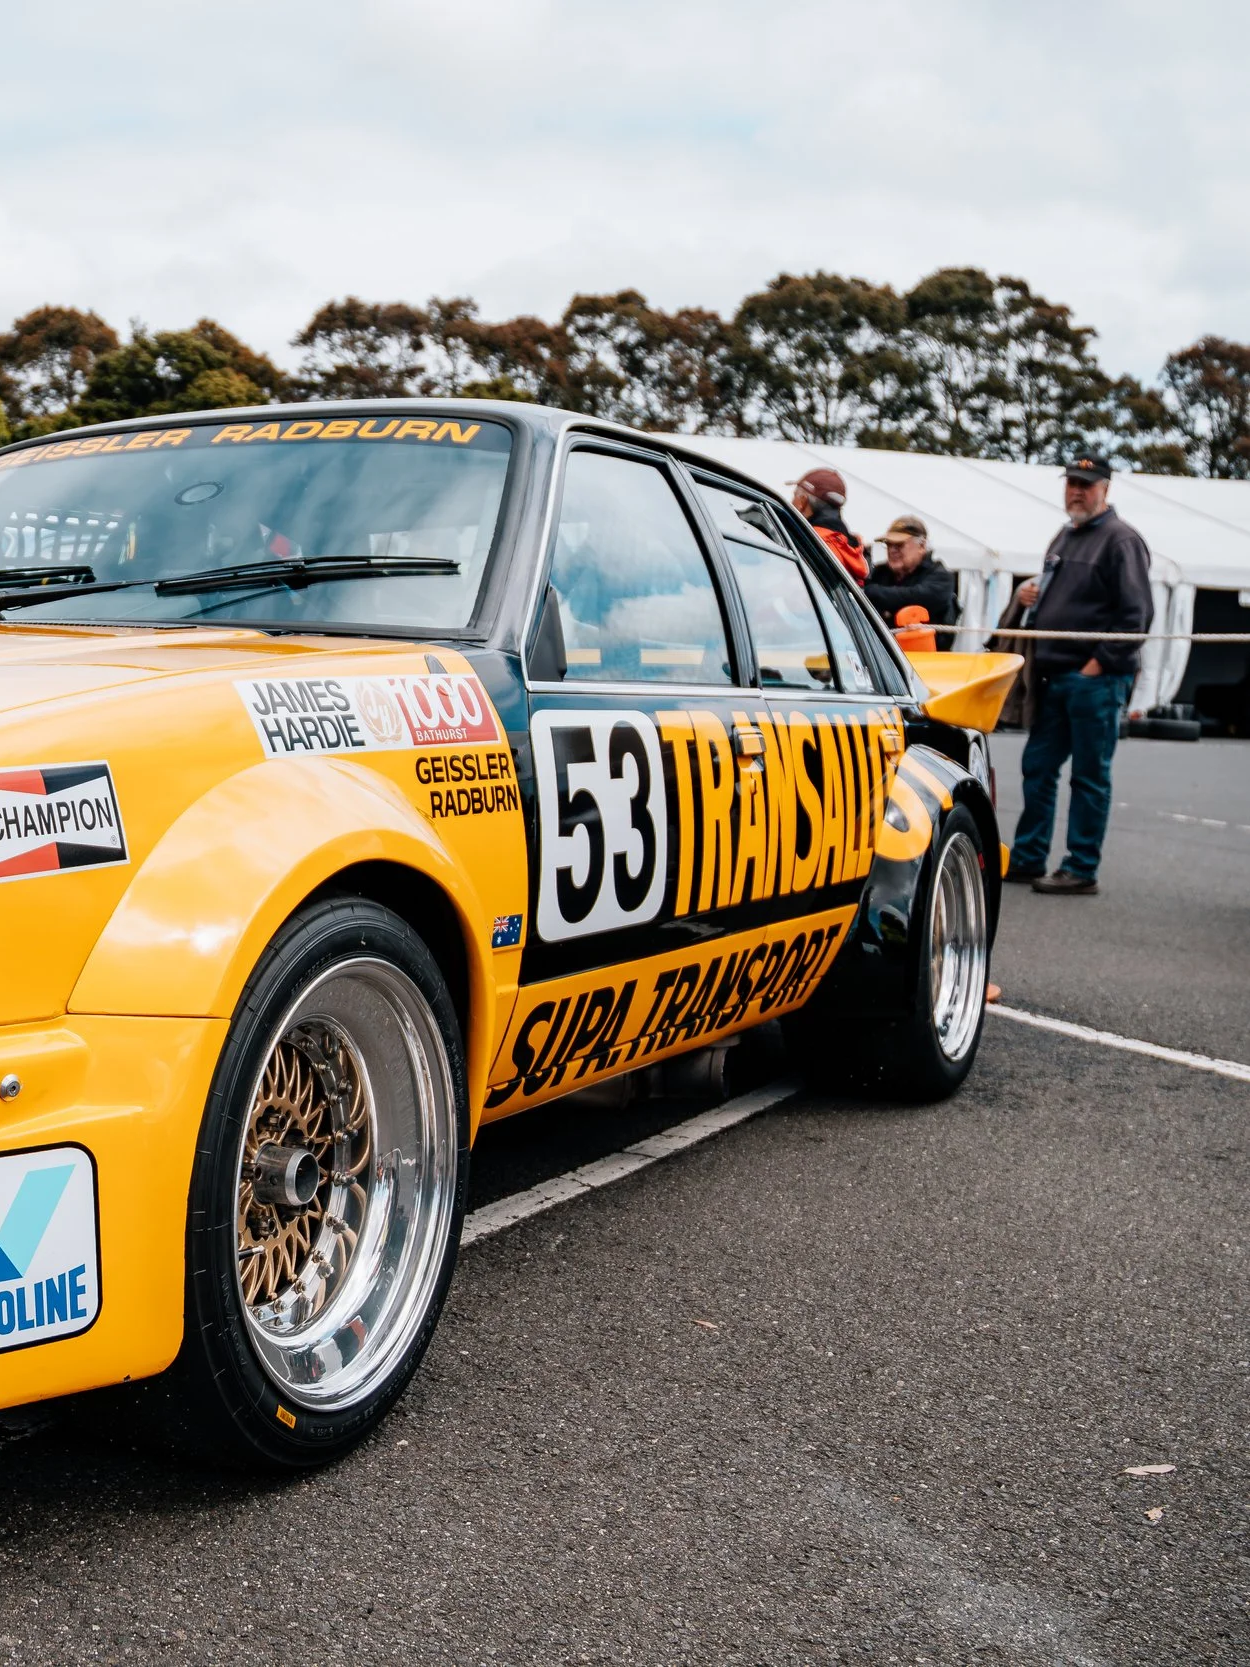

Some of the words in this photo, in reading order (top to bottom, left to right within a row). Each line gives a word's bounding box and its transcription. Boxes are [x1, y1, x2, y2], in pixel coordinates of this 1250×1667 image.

[211, 420, 481, 444] RADBURN
[252, 679, 351, 715] JAMES
[388, 677, 483, 729] 1000
[260, 713, 367, 753] HARDIE
[415, 728, 468, 743] BATHURST
[415, 752, 512, 785] GEISSLER
[430, 784, 519, 818] RADBURN
[549, 720, 655, 924] 53
[484, 979, 638, 1109] SUPA
[614, 923, 844, 1064] TRANSPORT
